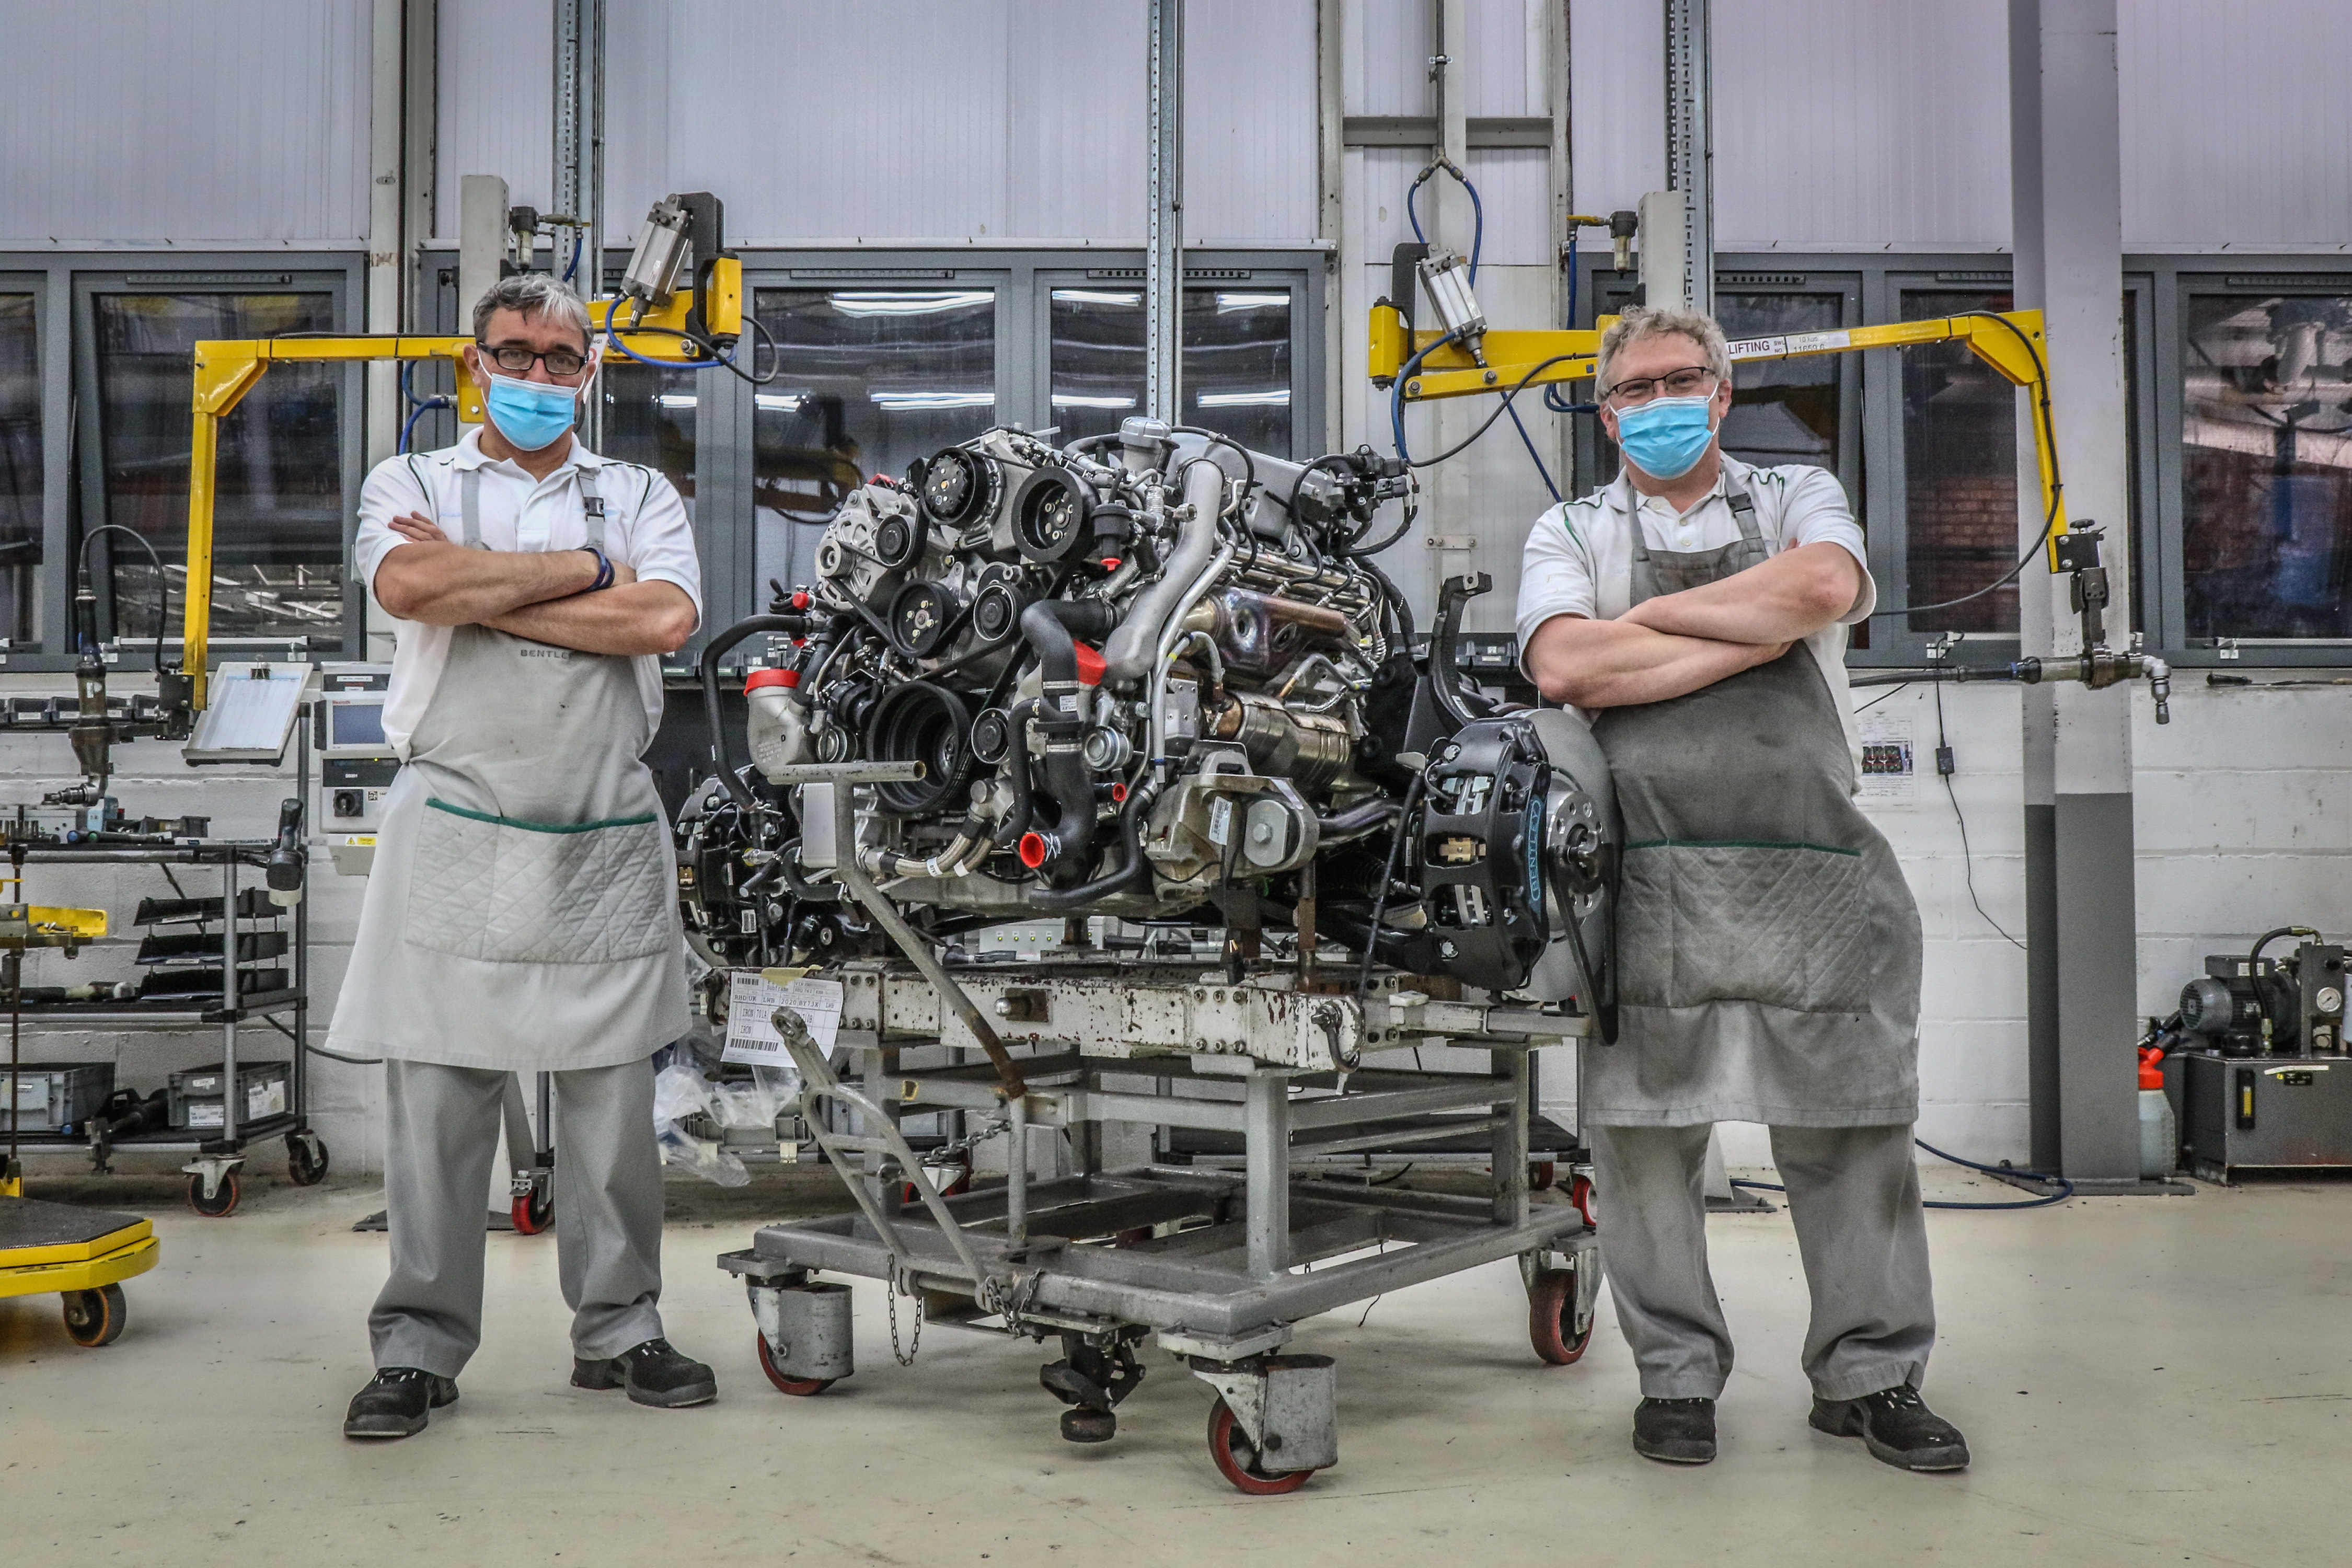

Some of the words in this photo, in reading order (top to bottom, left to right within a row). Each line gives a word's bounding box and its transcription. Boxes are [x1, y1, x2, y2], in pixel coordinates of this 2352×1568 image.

[1728, 340, 1770, 354] LIFTING
[521, 649, 570, 660] BENTLE
[1529, 809, 1539, 891] BENTLEY
[742, 1008, 754, 1017] IRON
[756, 1009, 767, 1019] 701A
[740, 1025, 752, 1034] IRON
